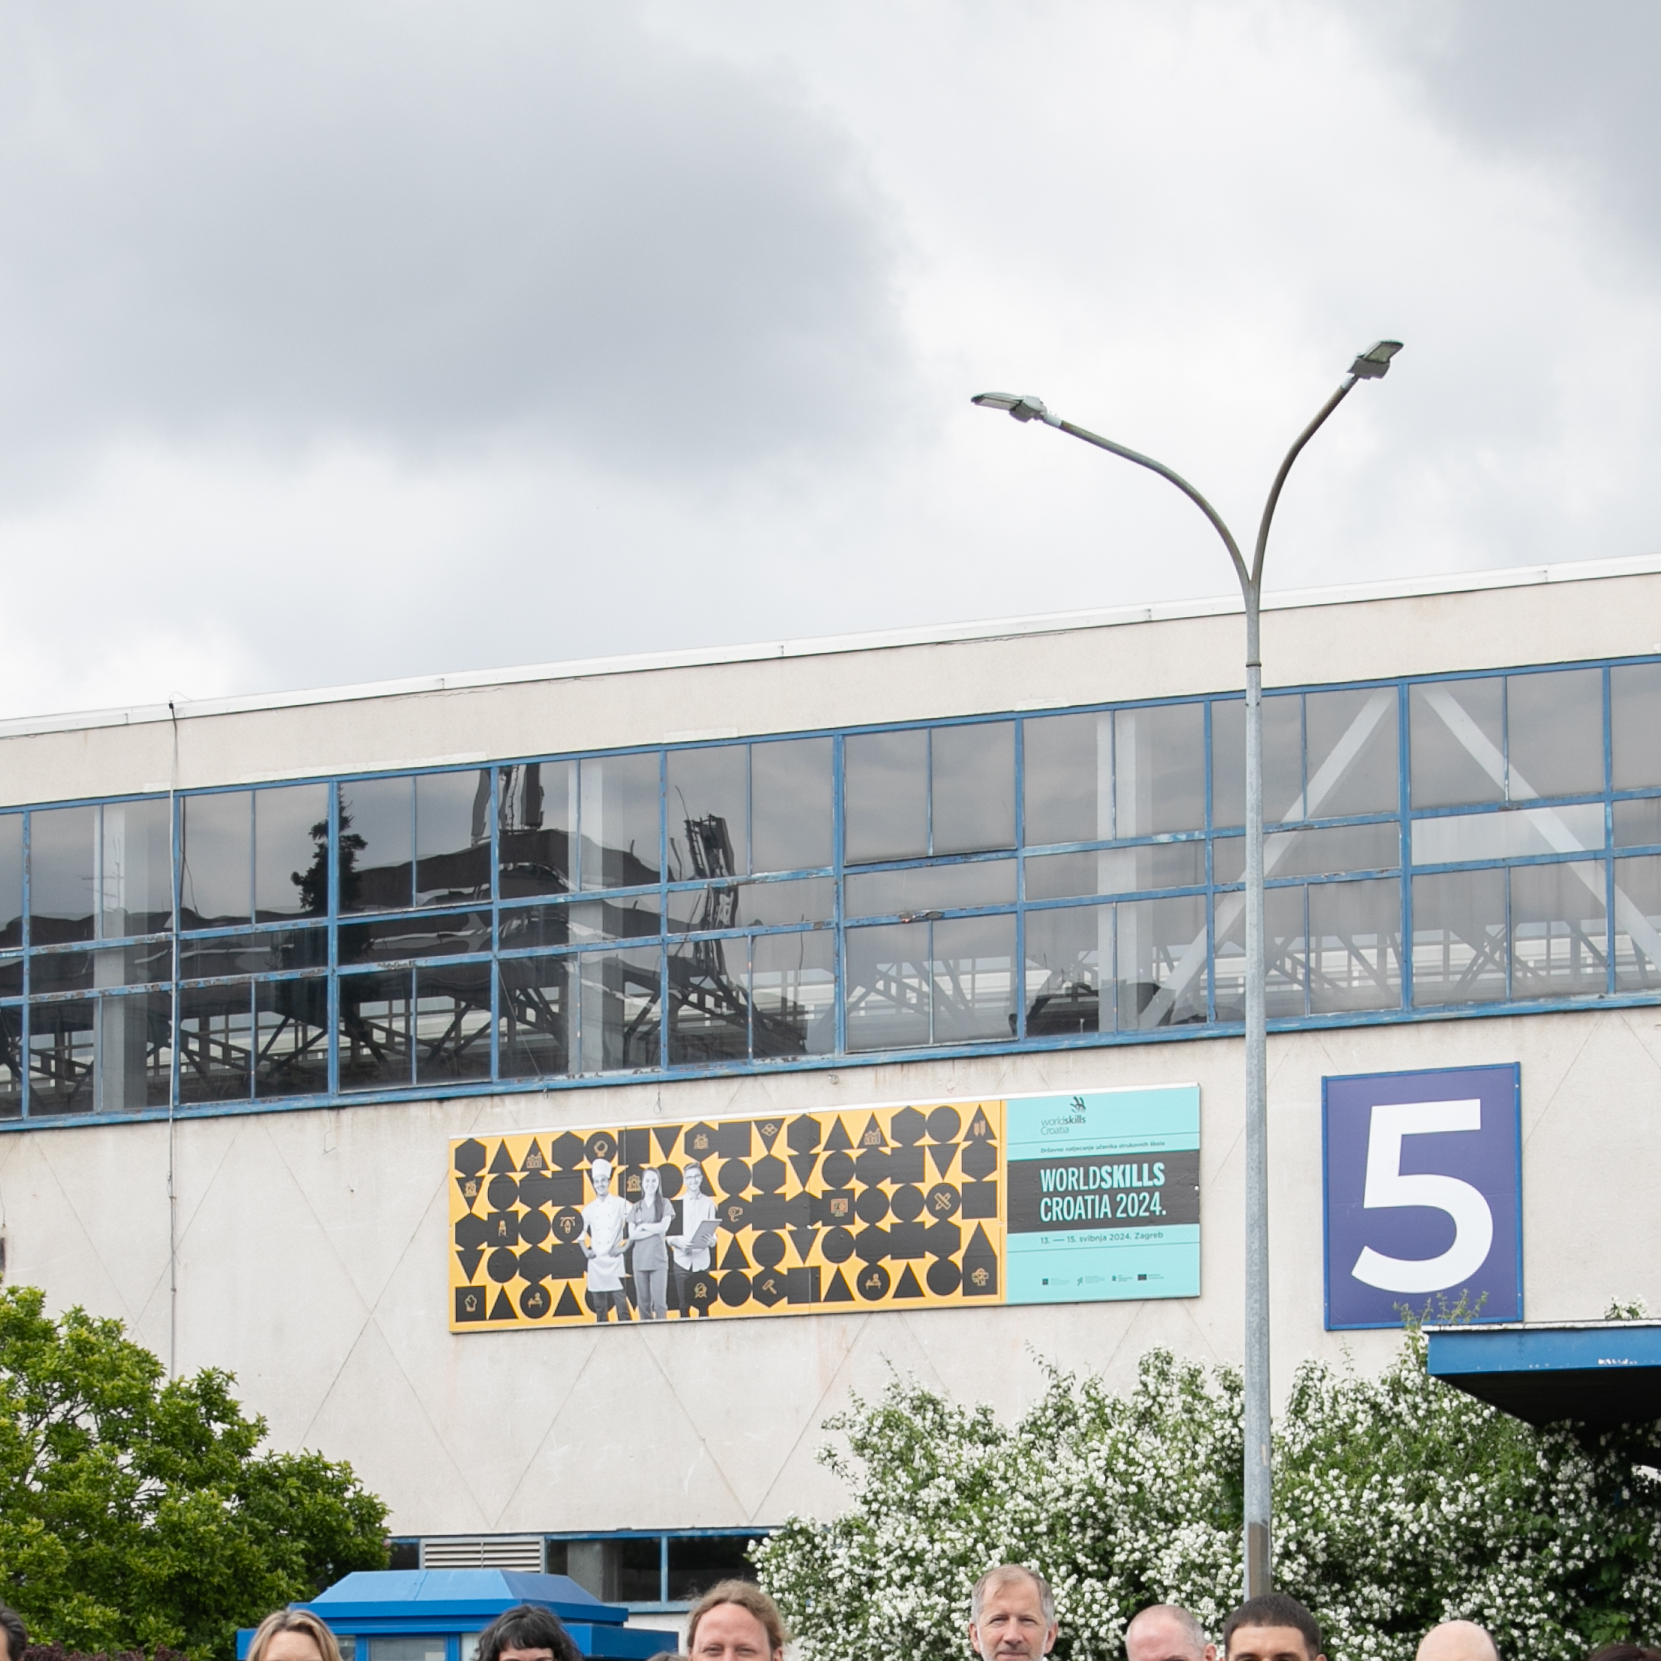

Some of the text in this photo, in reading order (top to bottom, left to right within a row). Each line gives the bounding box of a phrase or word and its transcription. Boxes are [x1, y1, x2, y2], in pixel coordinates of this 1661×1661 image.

[1040, 1114, 1086, 1126] worldskills
[1040, 1126, 1069, 1135] Croatia
[1040, 1162, 1166, 1192] WORLDSKILLS
[1351, 1098, 1493, 1293] 5
[1040, 1191, 1167, 1222] CROATIA 2024.
[1040, 1236, 1051, 1244] 13.
[1067, 1235, 1077, 1243] 15.
[1079, 1234, 1107, 1243] svibnja
[1109, 1233, 1132, 1241] 2024.
[1134, 1231, 1163, 1241] Zagreb
